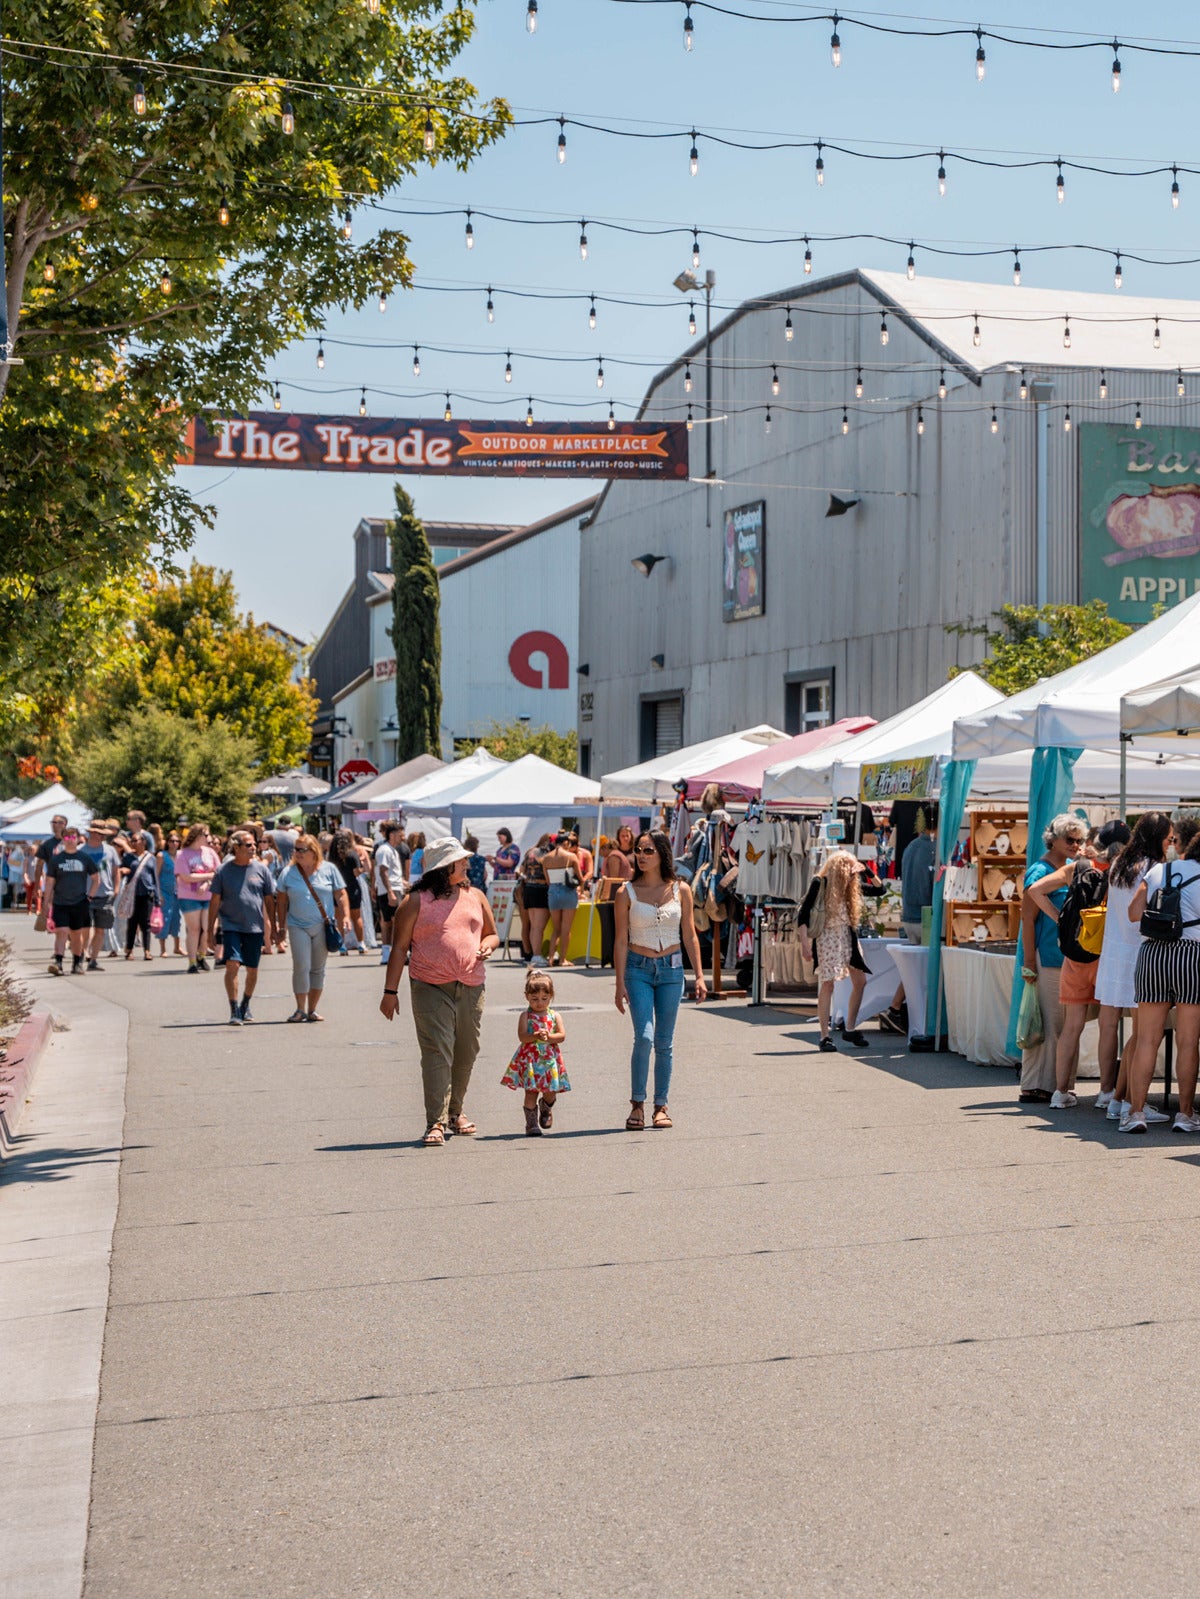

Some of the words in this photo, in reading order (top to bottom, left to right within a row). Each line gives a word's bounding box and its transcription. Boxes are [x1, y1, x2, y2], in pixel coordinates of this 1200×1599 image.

[213, 420, 300, 461] The
[315, 424, 451, 466] Trade
[482, 437, 547, 450] OUTDOOR
[553, 438, 648, 450] MARKETPLACE
[502, 460, 541, 468] ANTIQUES
[545, 460, 577, 468] MAKERS
[638, 461, 663, 469] MUSIC
